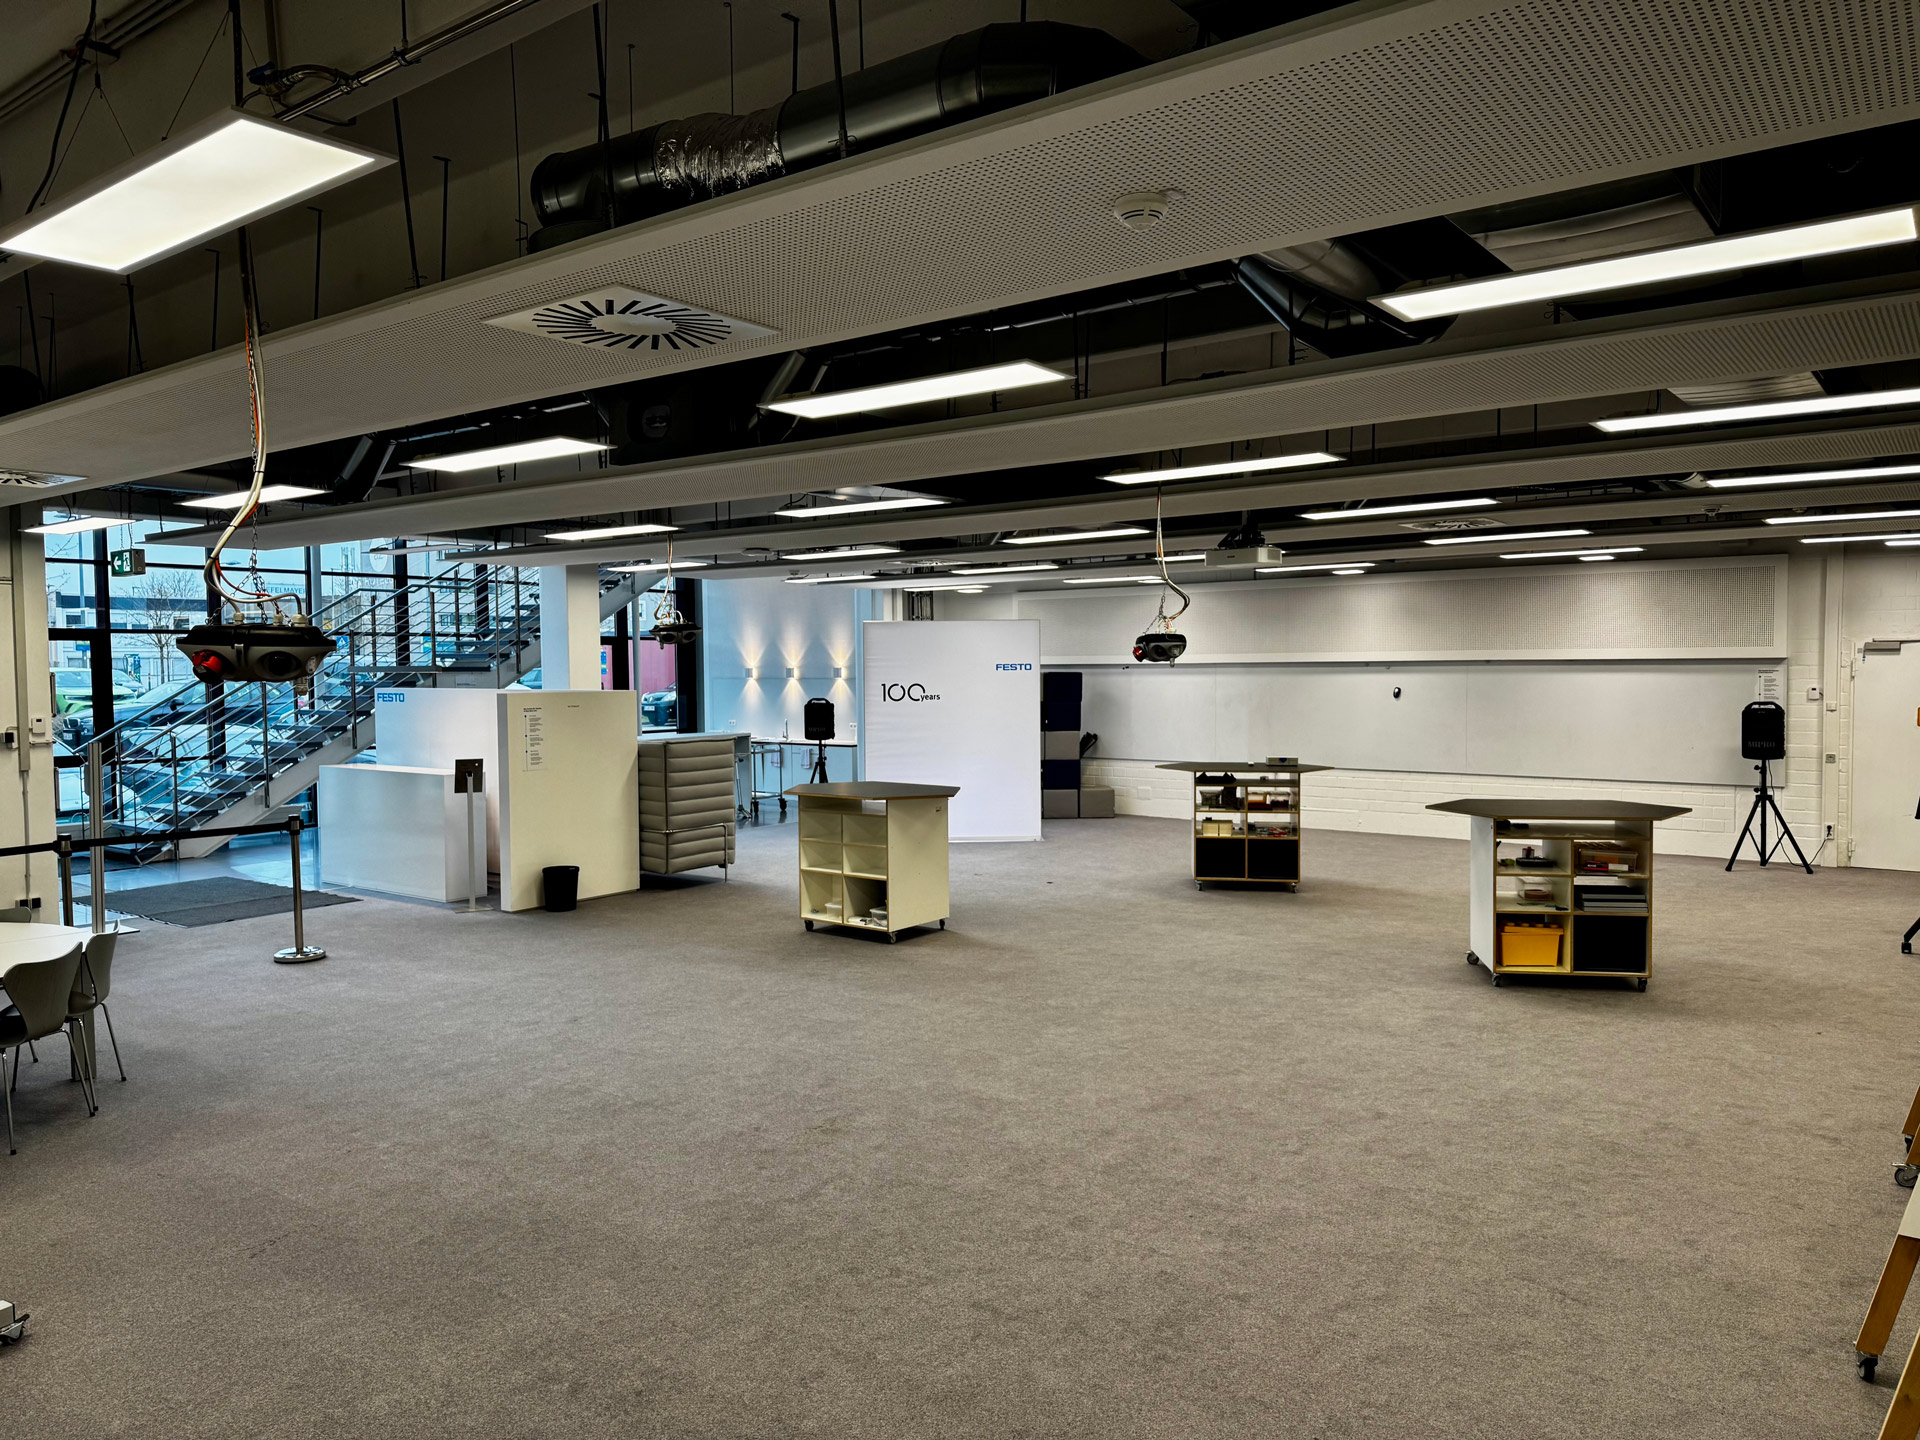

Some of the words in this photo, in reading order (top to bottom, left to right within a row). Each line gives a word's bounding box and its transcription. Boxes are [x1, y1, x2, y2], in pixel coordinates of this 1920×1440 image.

[995, 663, 1032, 671] FESTO
[377, 692, 405, 703] FESTO
[881, 683, 926, 702] 100
[920, 694, 941, 702] years
